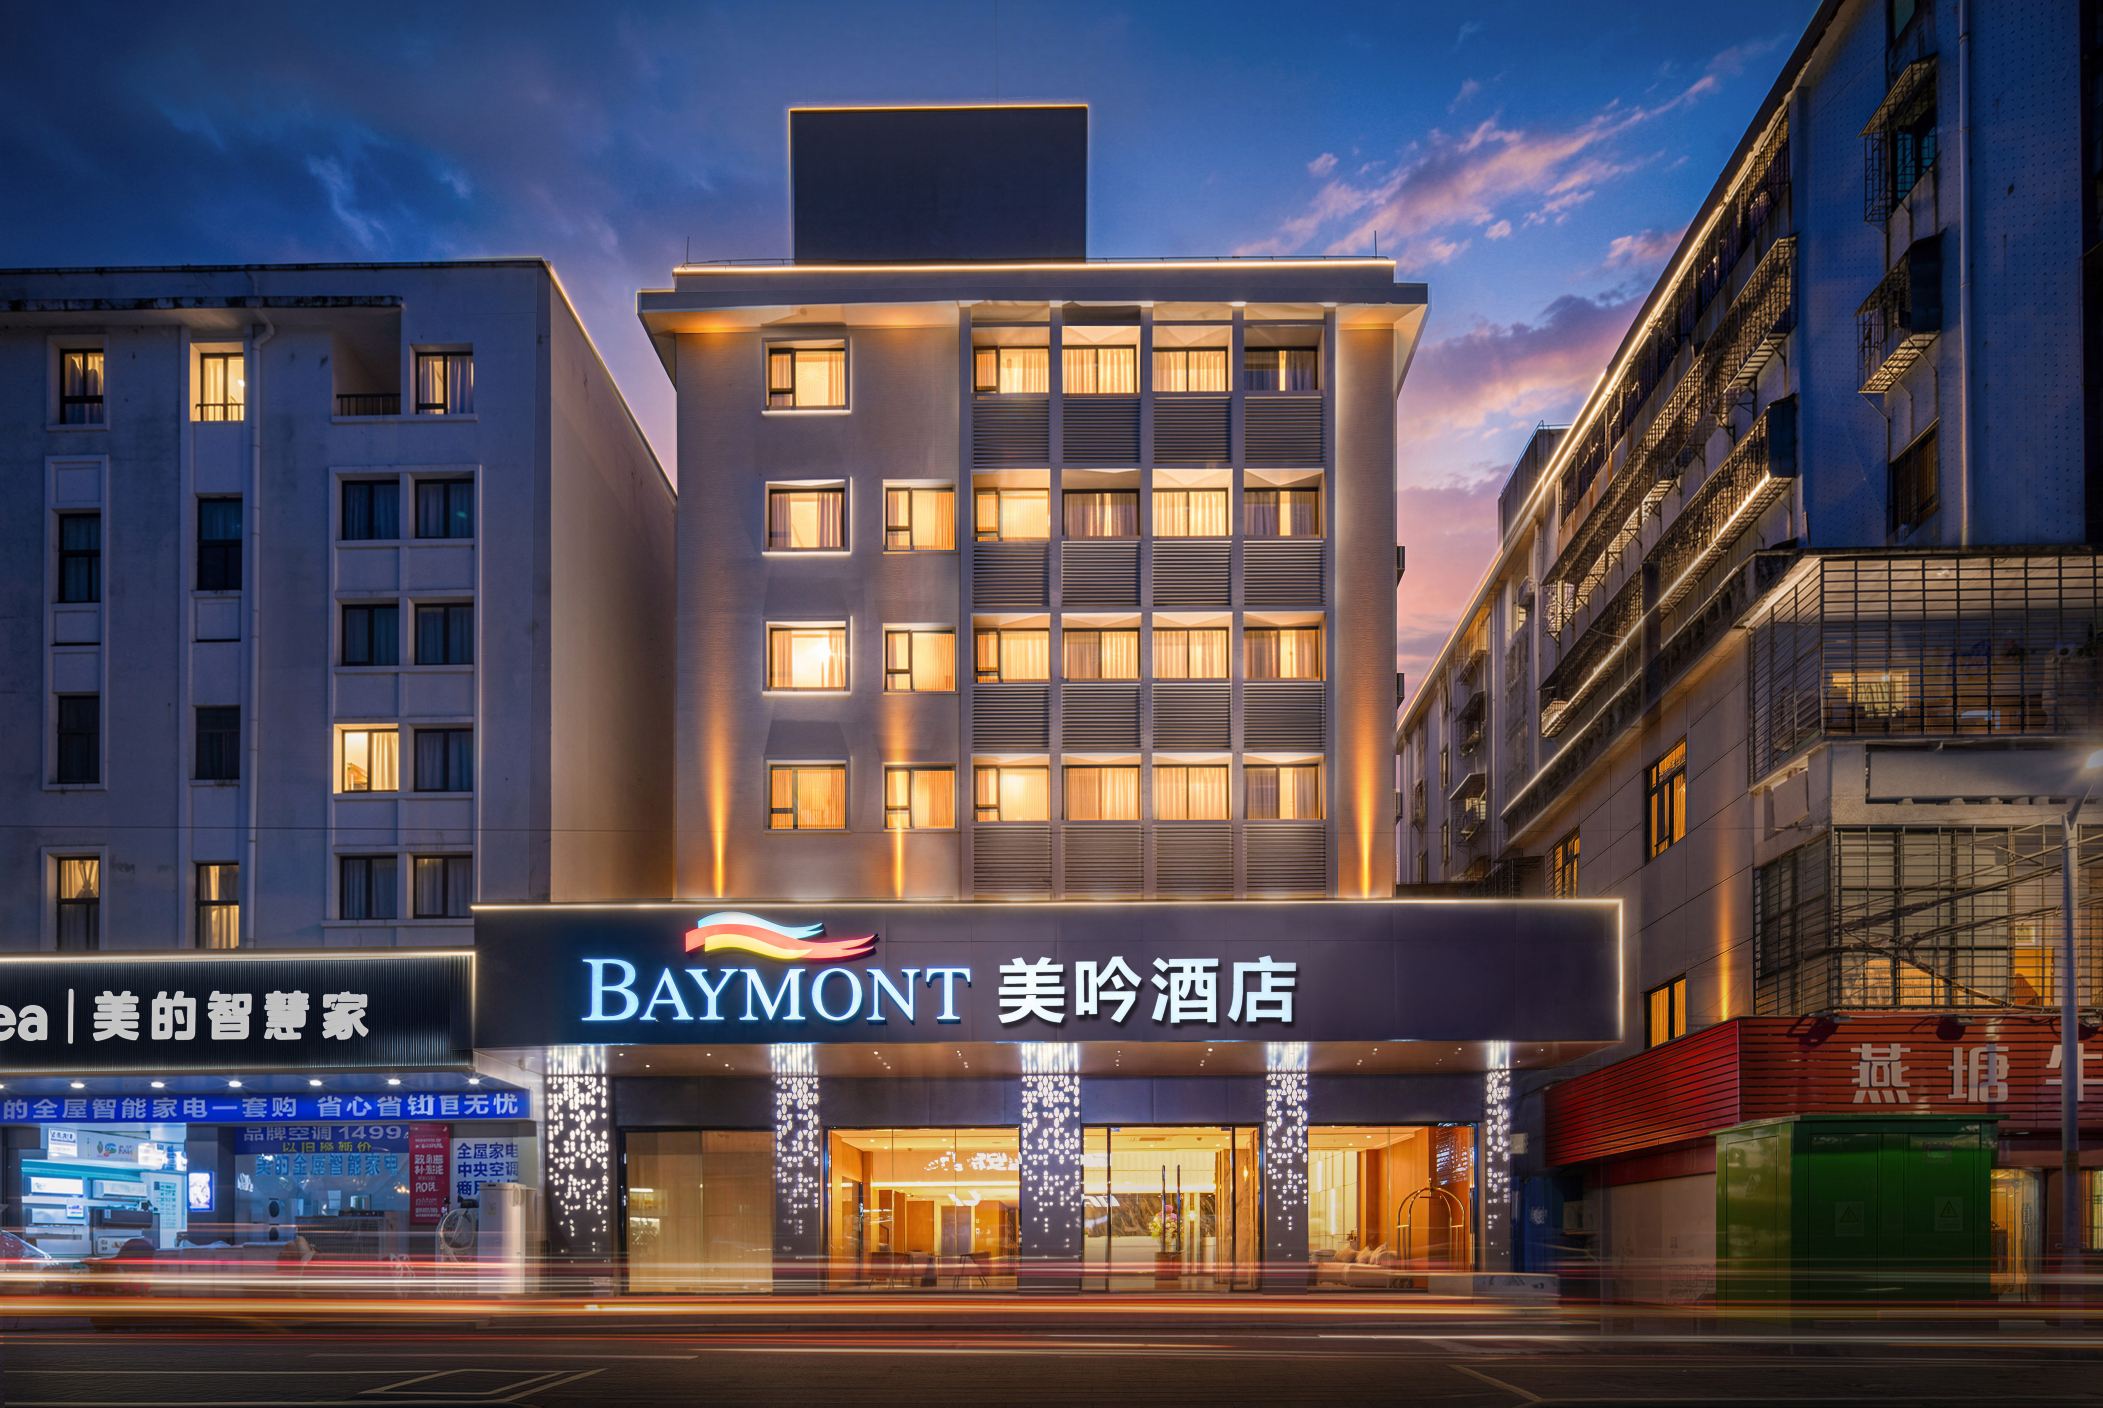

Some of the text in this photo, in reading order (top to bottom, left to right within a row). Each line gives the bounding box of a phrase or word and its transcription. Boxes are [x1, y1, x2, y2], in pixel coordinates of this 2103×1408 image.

[580, 957, 972, 1023] BAYMONT
[997, 955, 1298, 1024] 美吟酒店
[92, 990, 370, 1042] 美的智慧家
[3, 1096, 297, 1120] 的全屋智能家电一套购
[338, 1126, 409, 1140] 1499
[456, 1142, 519, 1160] 全屋家电
[457, 1161, 519, 1178] 中央空调
